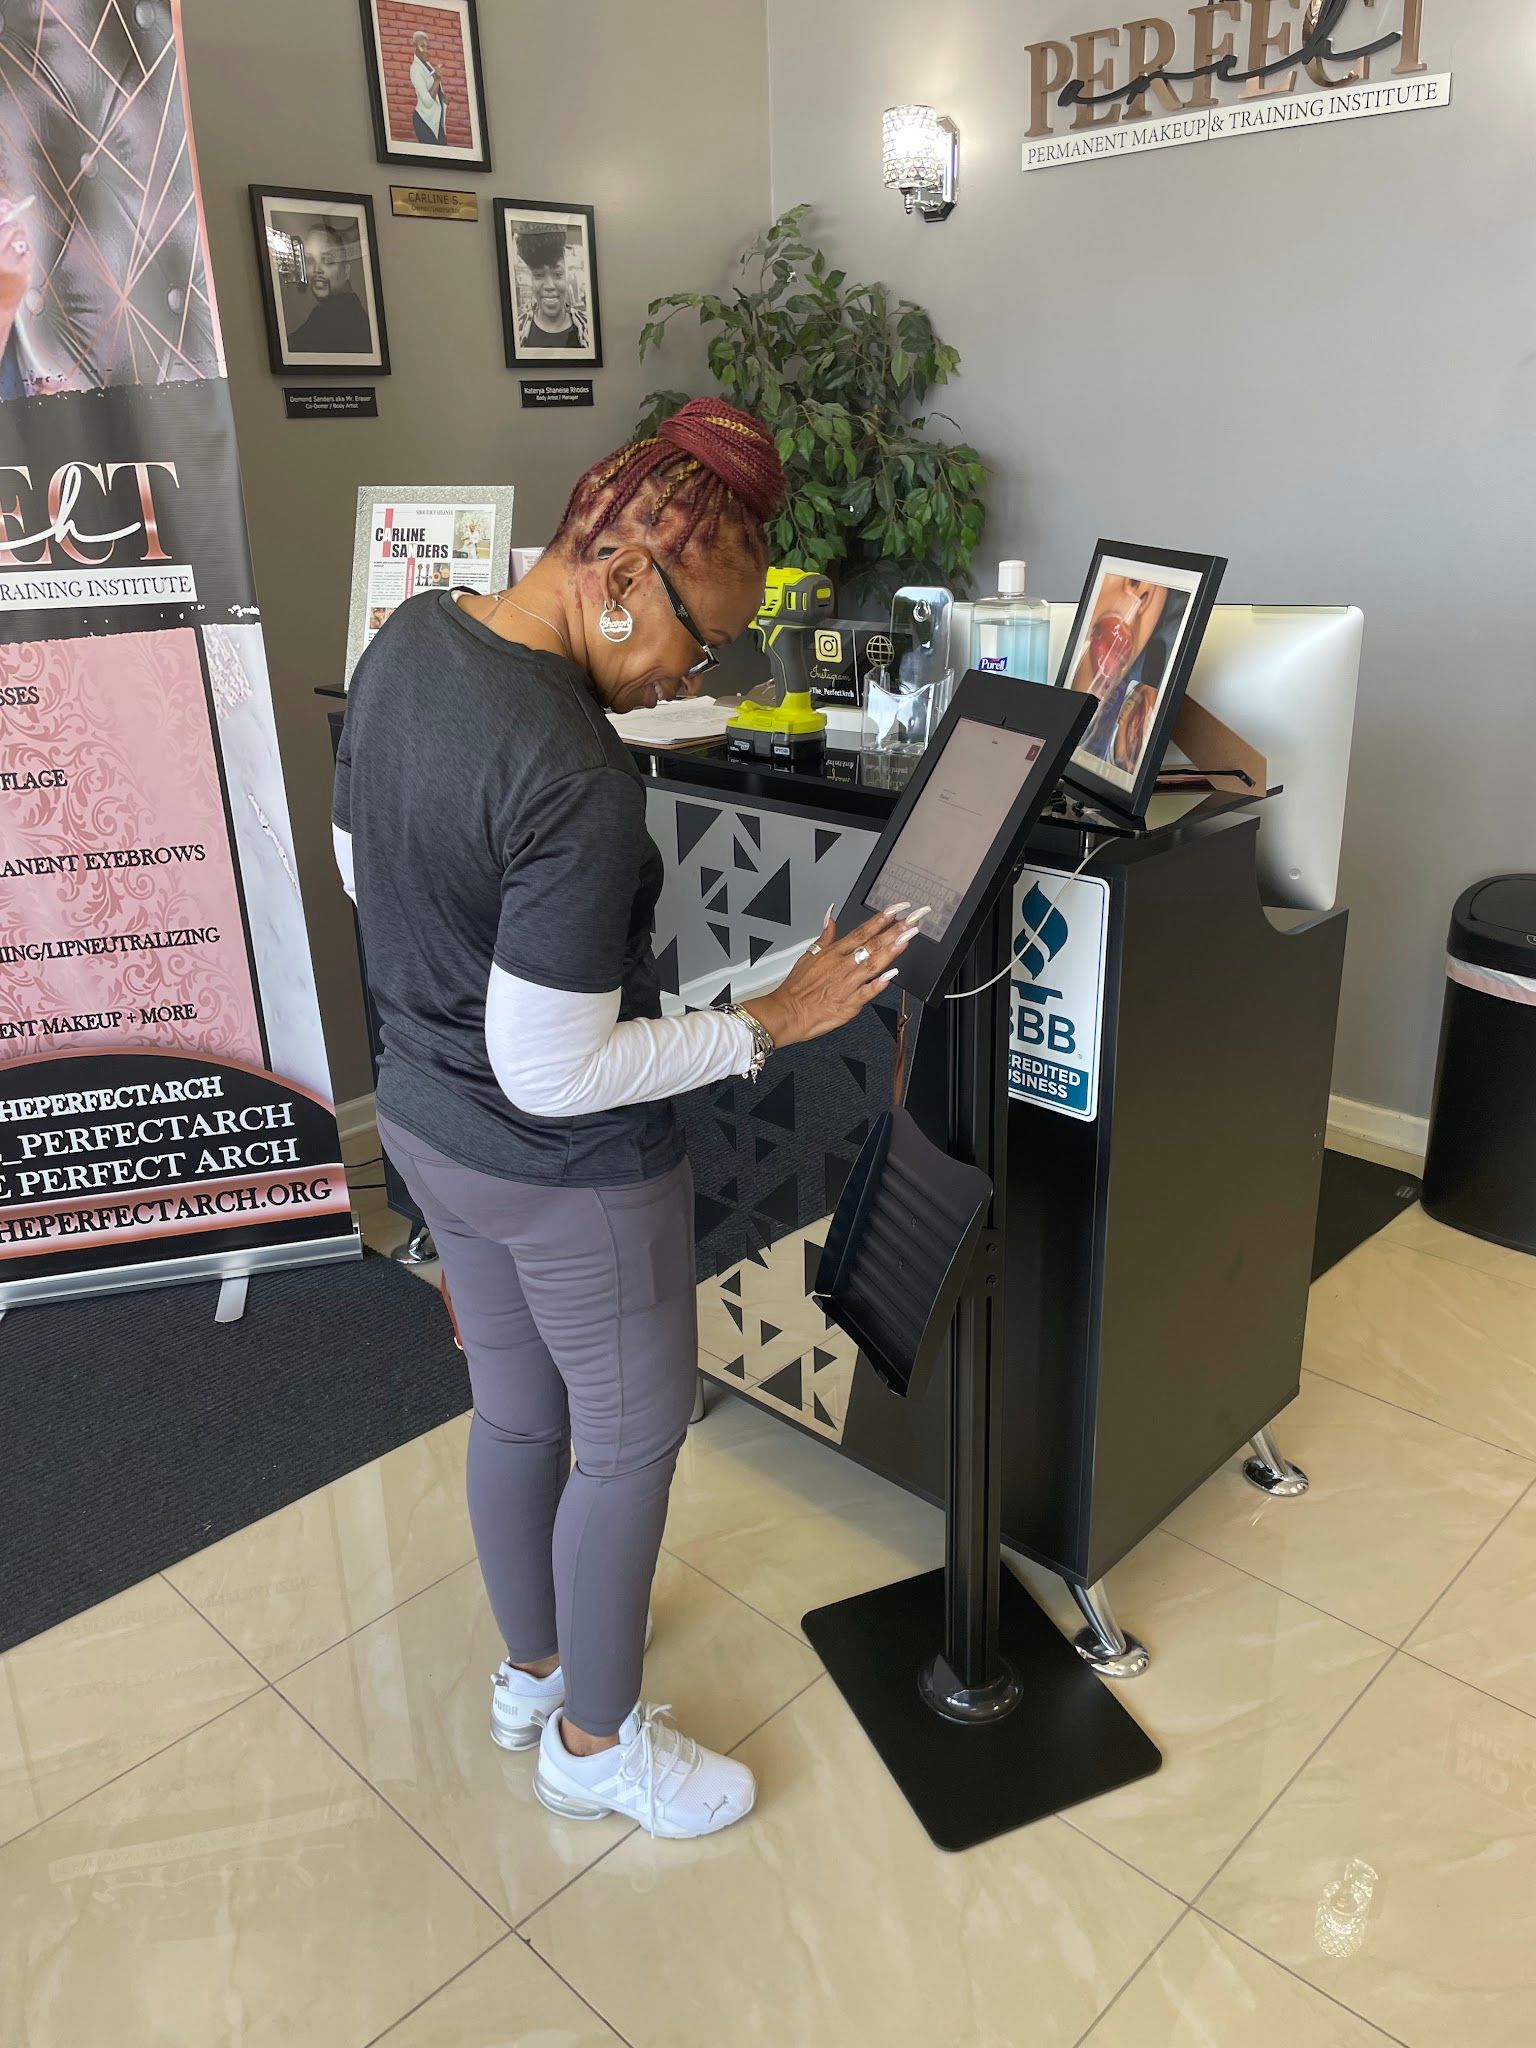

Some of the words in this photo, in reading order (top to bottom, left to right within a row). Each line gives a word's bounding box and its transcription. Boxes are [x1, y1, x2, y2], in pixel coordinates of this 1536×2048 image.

[1024, 0, 1428, 137] PERFECT
[1027, 131, 1128, 164] PERMANENT
[1132, 117, 1207, 146] MAKEUP
[1211, 115, 1225, 133] &
[1229, 98, 1324, 131] TRAINING
[1329, 81, 1438, 115] INSTITUTE
[408, 192, 449, 205] CARLINE
[452, 196, 463, 206] S.
[375, 528, 426, 542] CARLINE
[392, 543, 449, 558] SANDERS
[0, 580, 83, 601] RAINING
[88, 575, 192, 597] INSTITUTE
[810, 664, 852, 688] Instagram
[0, 769, 68, 790] FLAGE
[85, 844, 206, 871] EYEBROWS
[0, 927, 221, 962] ING/LIPNEUTRALIZING
[0, 1020, 38, 1040] ENT
[40, 1010, 123, 1035] MAKEUP
[127, 1013, 137, 1024] +
[141, 1003, 198, 1024] MORE
[1009, 1053, 1081, 1087] REDITED
[0, 1076, 224, 1123] HEPERFECTARCH
[0, 1102, 296, 1166] _PERFECTARCH
[16, 1152, 187, 1197] PERFECT
[194, 1137, 300, 1174] ARCH
[0, 1178, 333, 1243] HEPERFECTARCH.ORG
